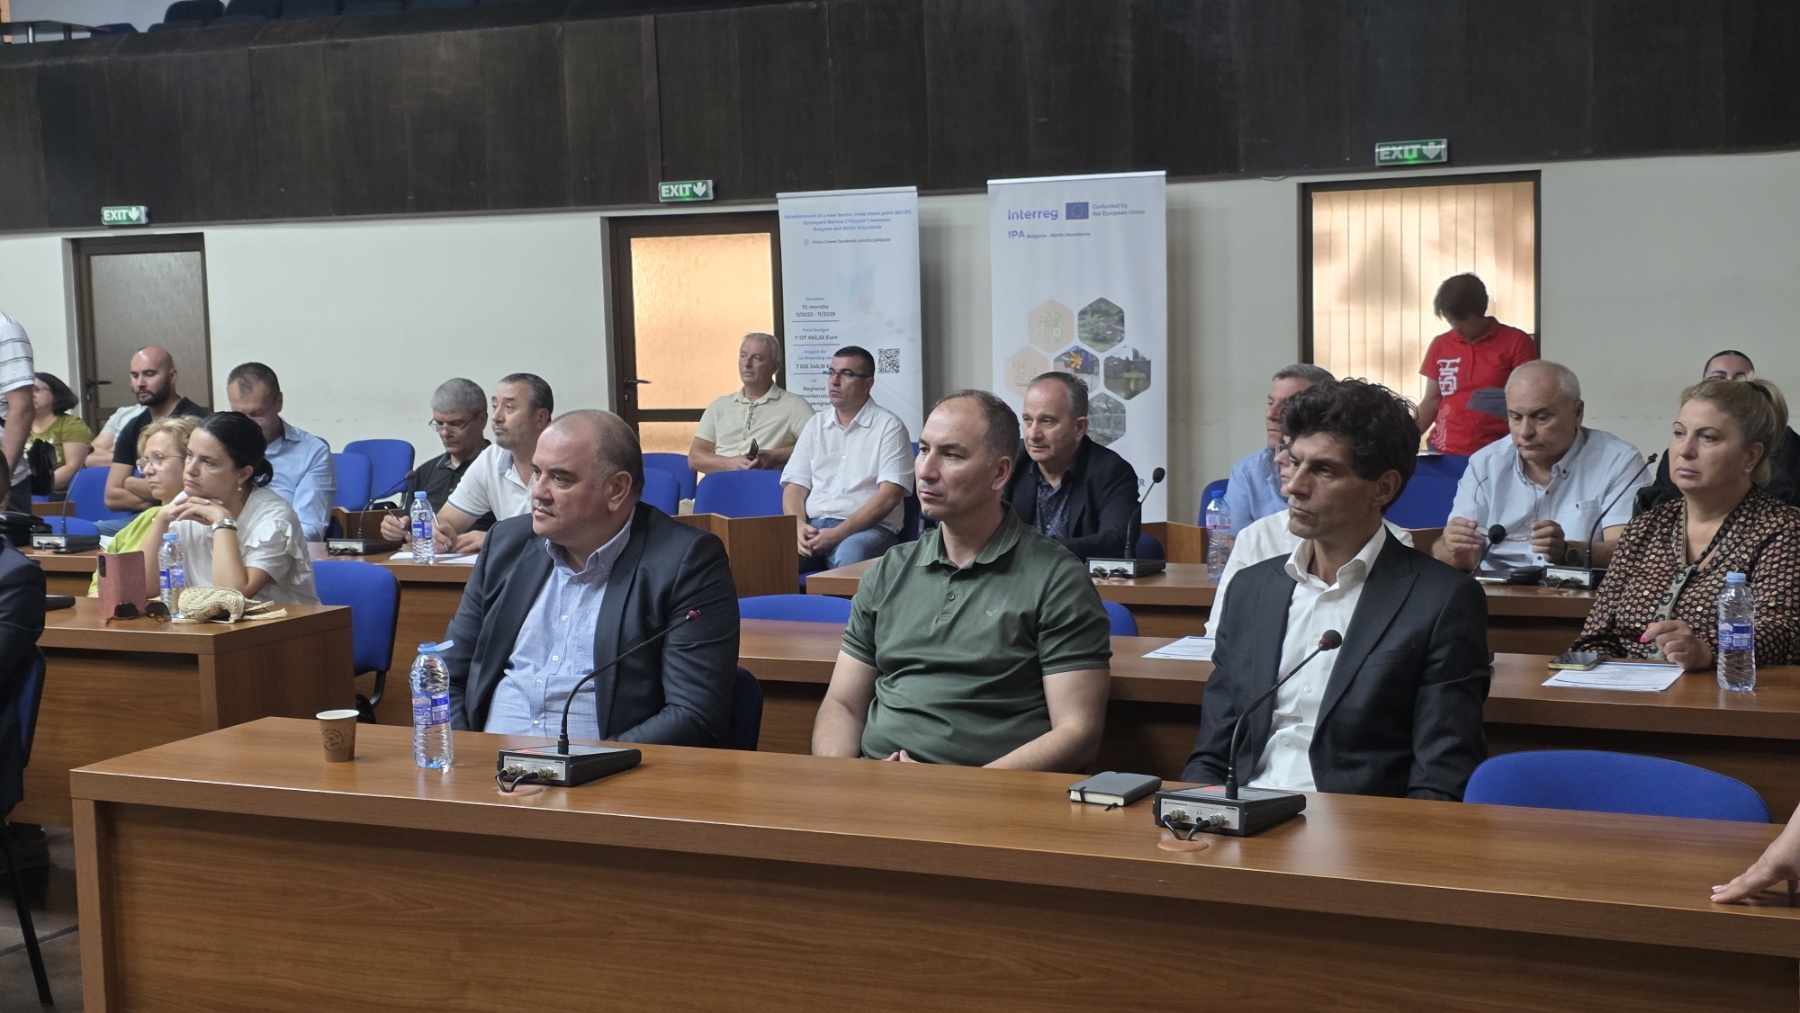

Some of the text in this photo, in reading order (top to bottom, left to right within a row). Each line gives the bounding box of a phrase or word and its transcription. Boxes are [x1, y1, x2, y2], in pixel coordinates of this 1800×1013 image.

[1380, 145, 1421, 160] EXIT
[661, 184, 692, 197] EXIT
[103, 209, 128, 221] EXIT
[1008, 209, 1059, 220] Interreg
[1008, 230, 1025, 239] IPA
